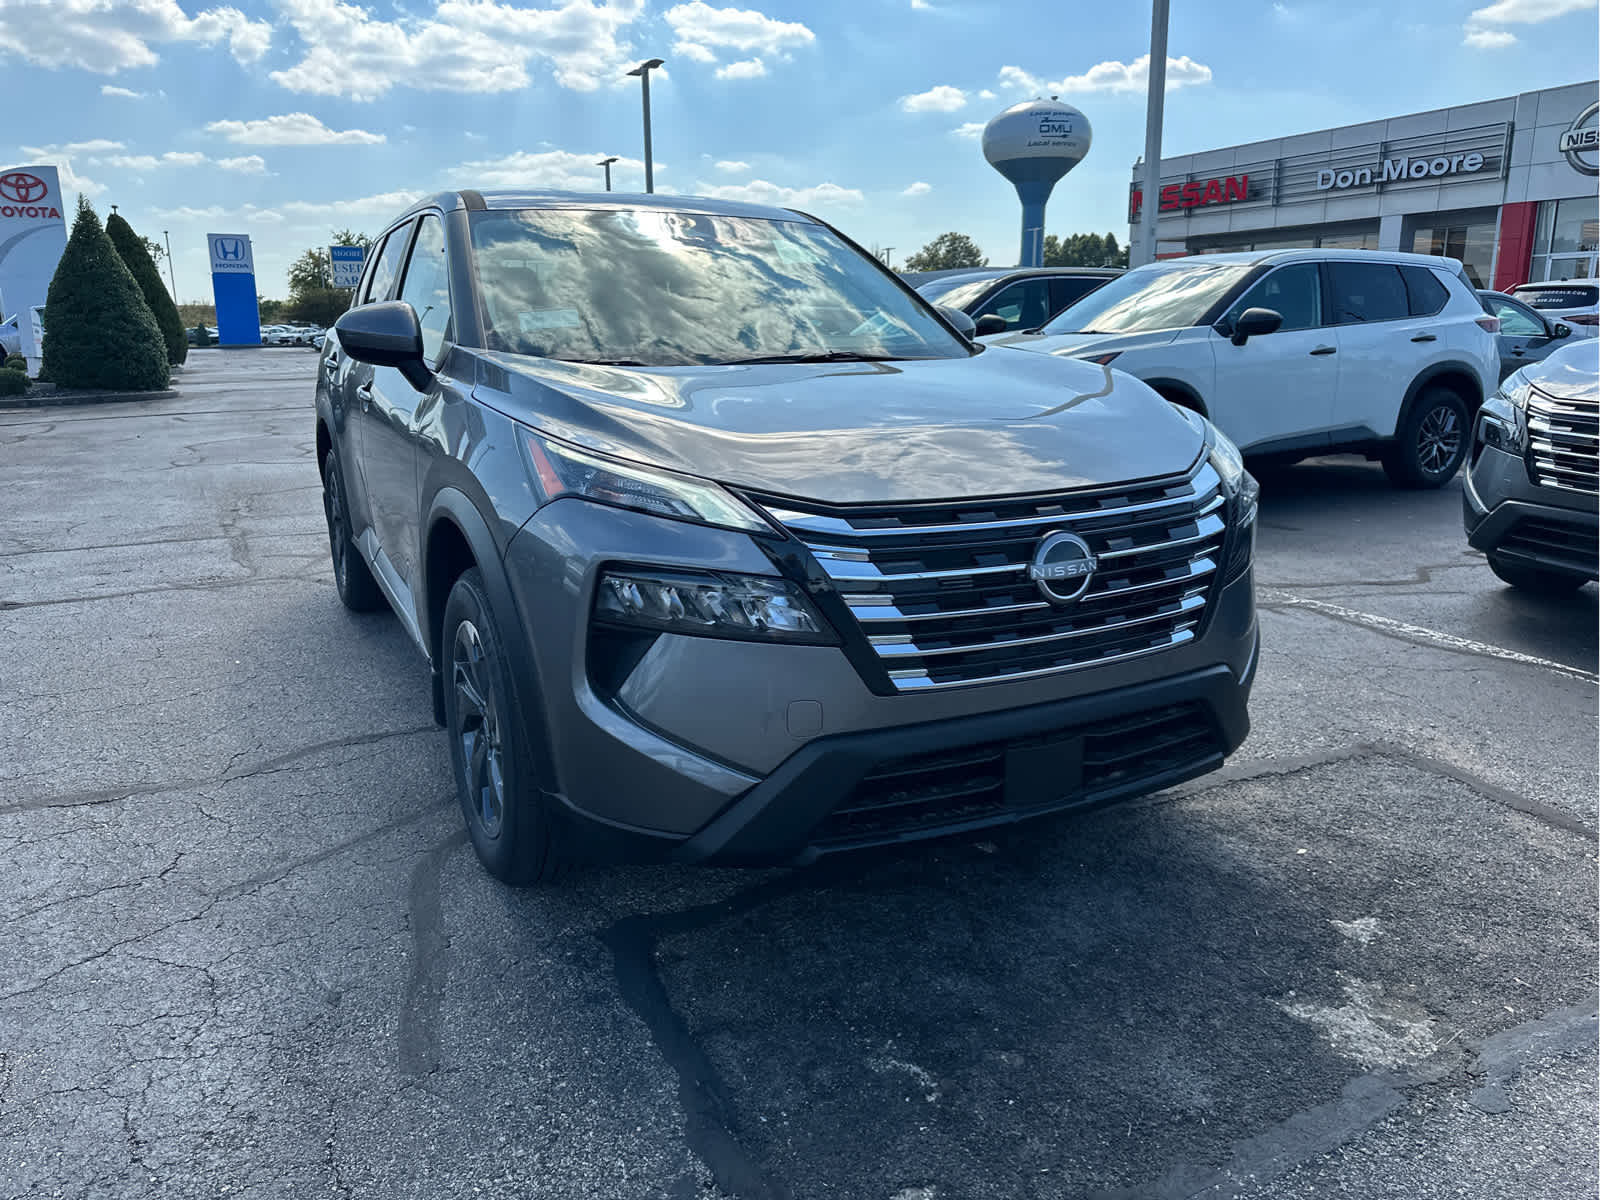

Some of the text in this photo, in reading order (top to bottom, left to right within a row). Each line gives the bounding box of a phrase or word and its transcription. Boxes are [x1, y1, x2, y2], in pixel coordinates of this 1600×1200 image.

[1317, 152, 1484, 191] Don Moore
[1131, 175, 1249, 214] NSSAN
[334, 263, 364, 273] USED
[334, 275, 359, 285] CAR
[1032, 560, 1097, 578] NISSAN
